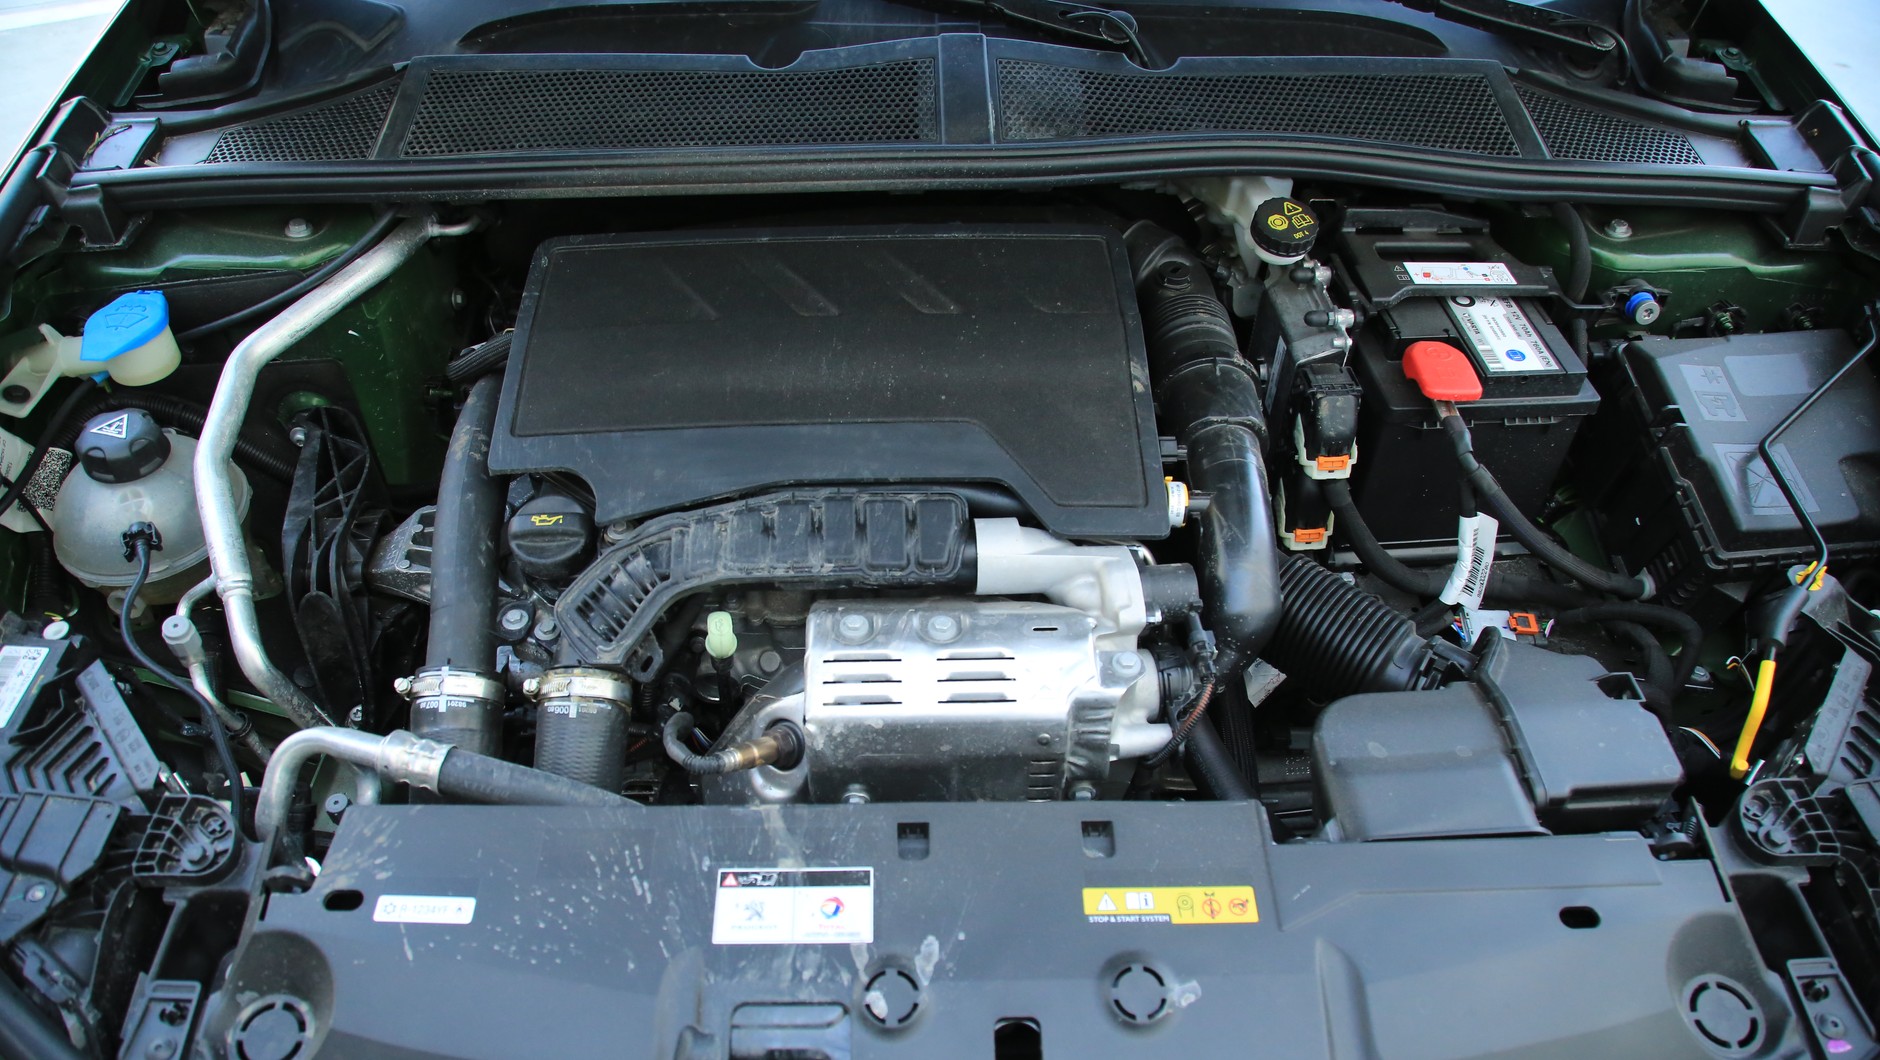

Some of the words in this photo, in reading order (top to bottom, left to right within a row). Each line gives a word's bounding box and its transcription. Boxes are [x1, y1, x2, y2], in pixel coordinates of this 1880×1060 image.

[1293, 231, 1304, 239] DOT
[1511, 311, 1522, 320] 12V
[1521, 323, 1532, 338] 70Ah
[1531, 340, 1544, 355] 760A
[1088, 915, 1109, 923] STOP
[1117, 915, 1140, 923] START
[1141, 914, 1170, 923] SYSTEM
